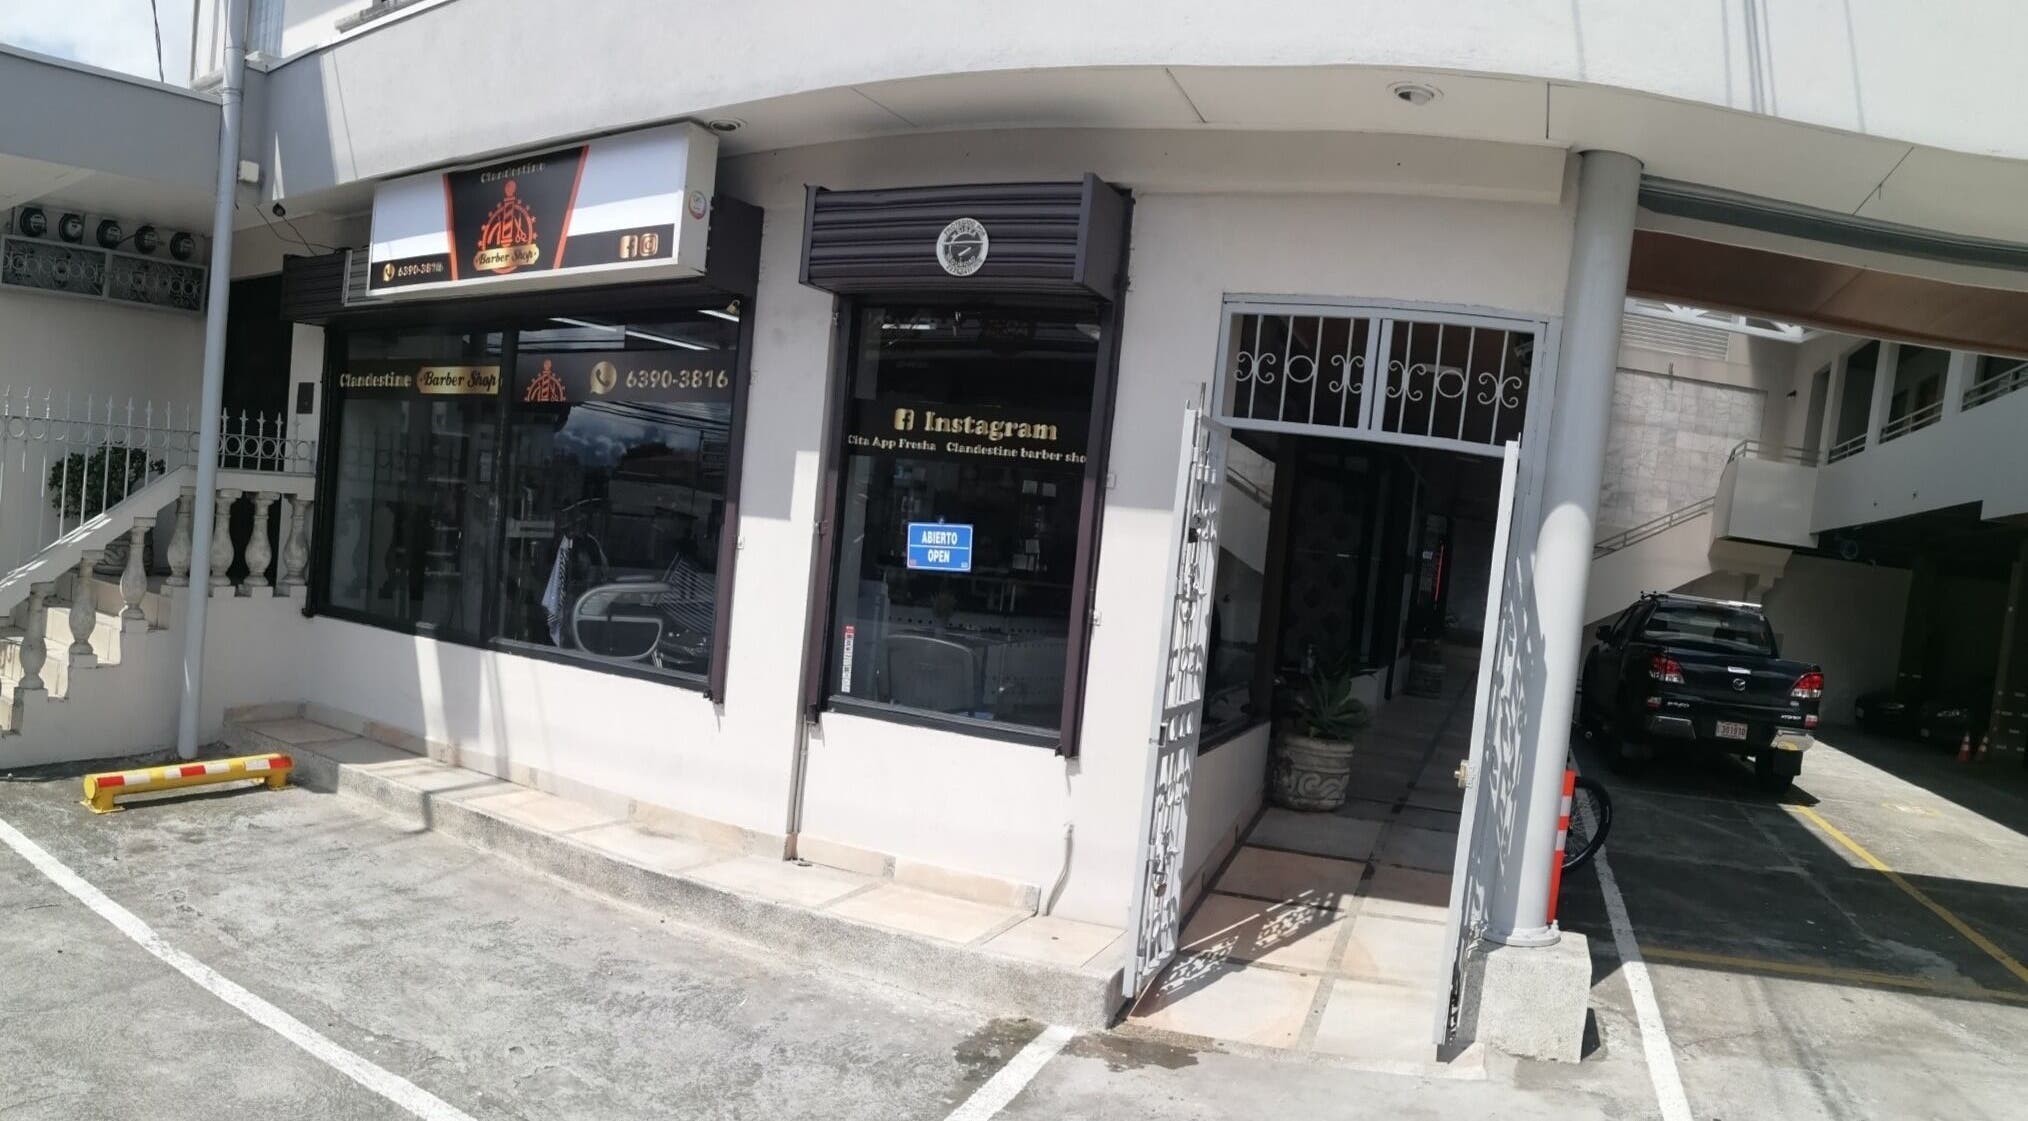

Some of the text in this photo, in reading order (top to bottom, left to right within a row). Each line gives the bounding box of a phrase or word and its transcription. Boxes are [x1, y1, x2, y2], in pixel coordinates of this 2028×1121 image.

[478, 248, 534, 265] Barber Shop
[339, 369, 498, 392] Clandestine Barber Shop
[625, 369, 730, 390] 6390-3816
[924, 410, 1058, 441] Instagram
[847, 434, 1087, 464] Cita App Fresha Clandestine barber sho
[921, 530, 958, 546] ABIERTO
[927, 548, 951, 563] OPEN
